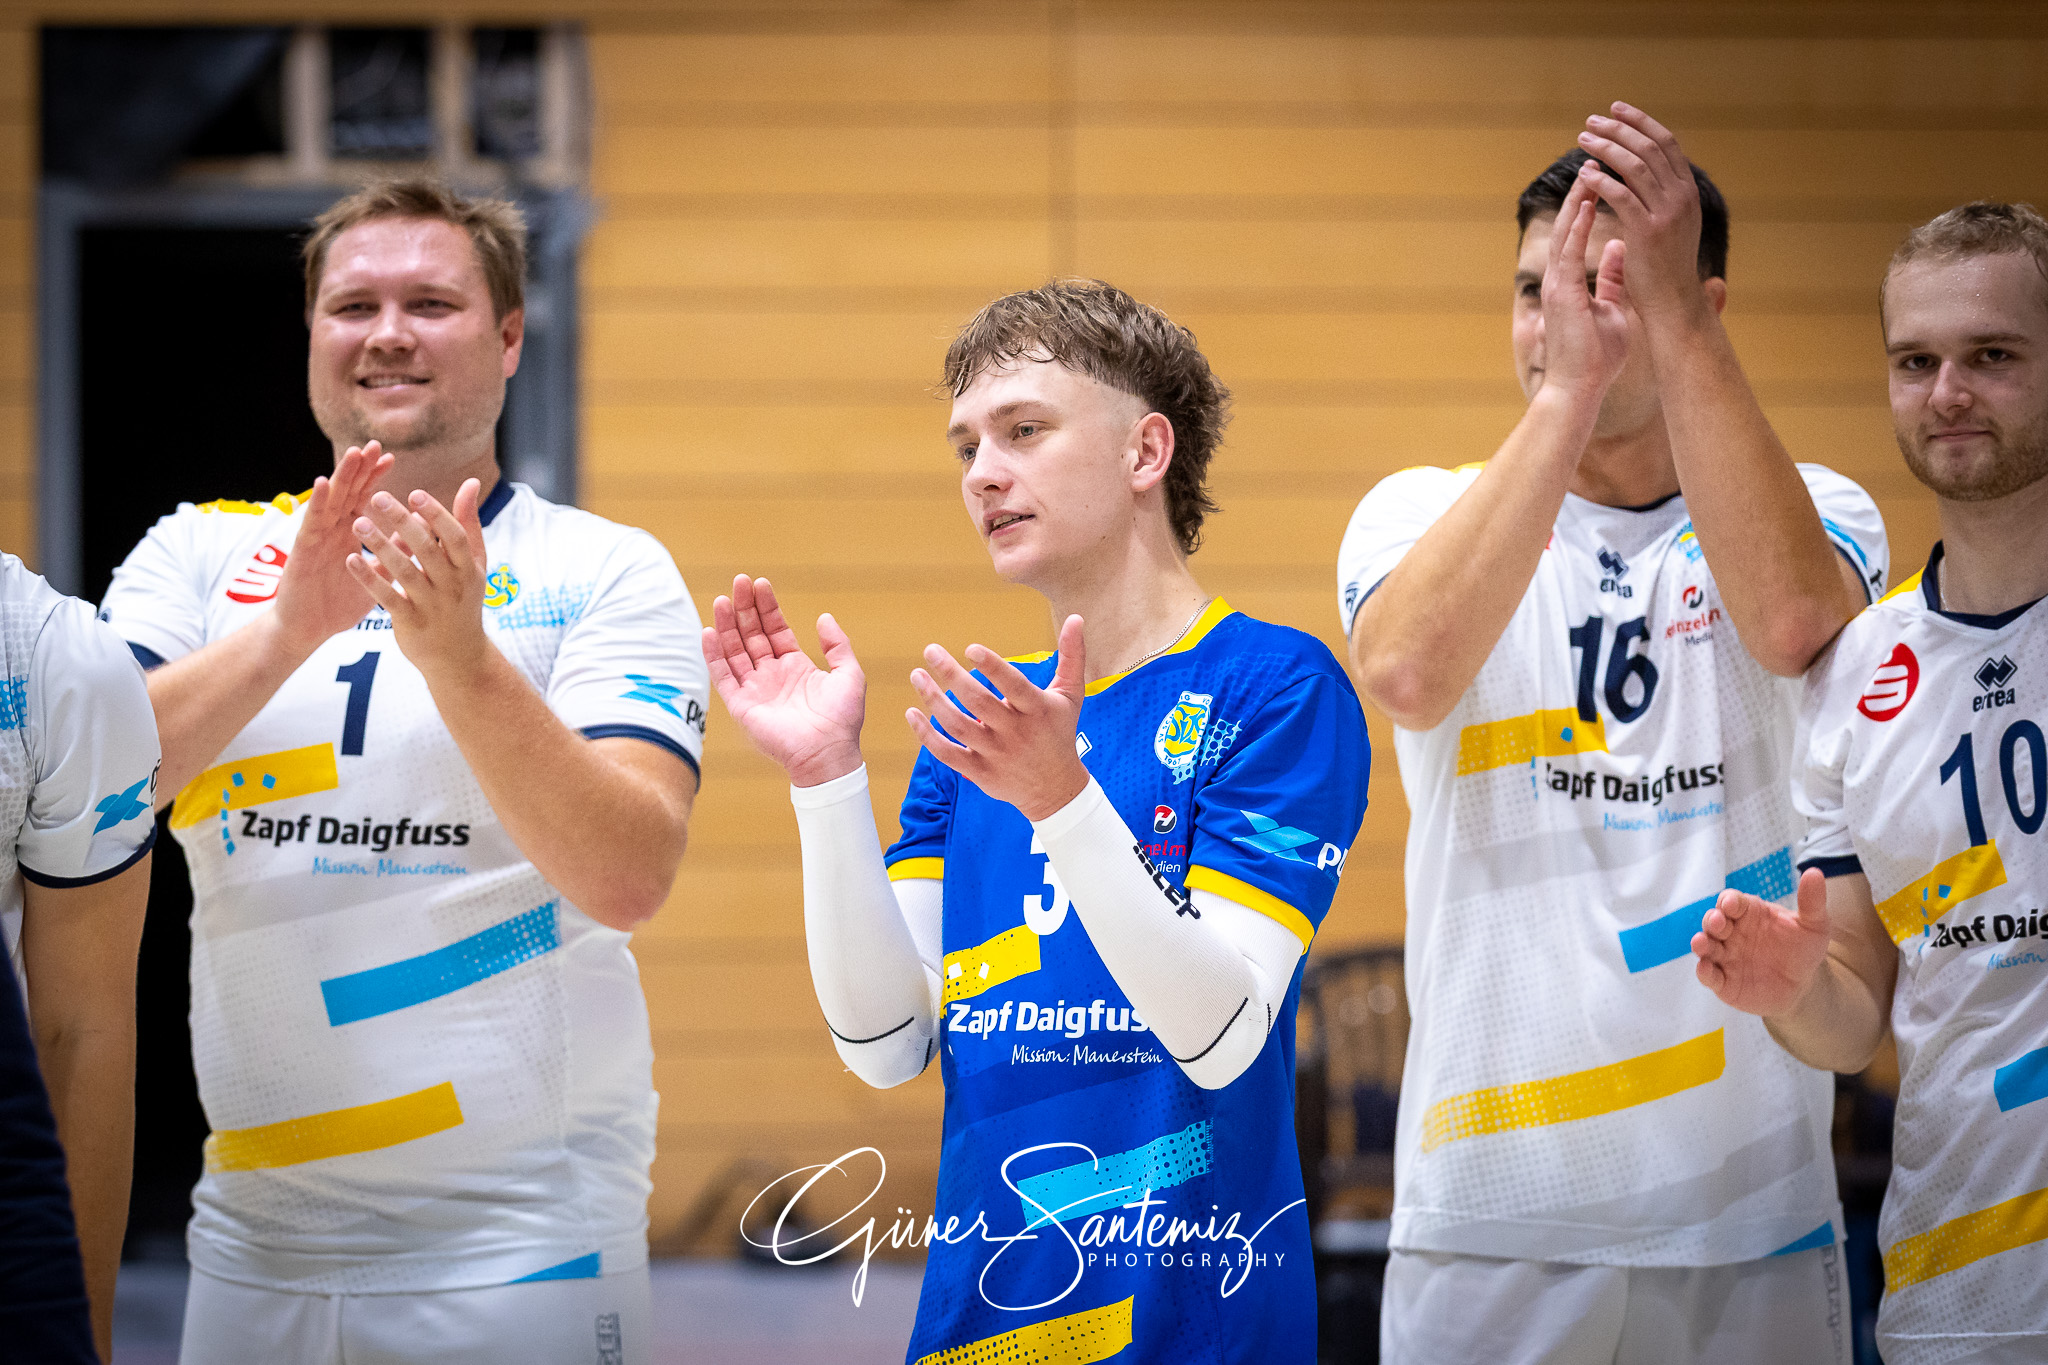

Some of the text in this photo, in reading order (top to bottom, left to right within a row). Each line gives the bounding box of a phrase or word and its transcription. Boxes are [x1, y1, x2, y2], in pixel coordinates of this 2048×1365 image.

[336, 652, 380, 755] 1
[1570, 616, 1658, 723] 16
[241, 810, 471, 852] Zapf Daigfuss
[1547, 762, 1596, 800] apf
[1940, 719, 2048, 847] 10
[1023, 831, 1070, 935] 3
[948, 1000, 1153, 1040] Zapf Daigfus
